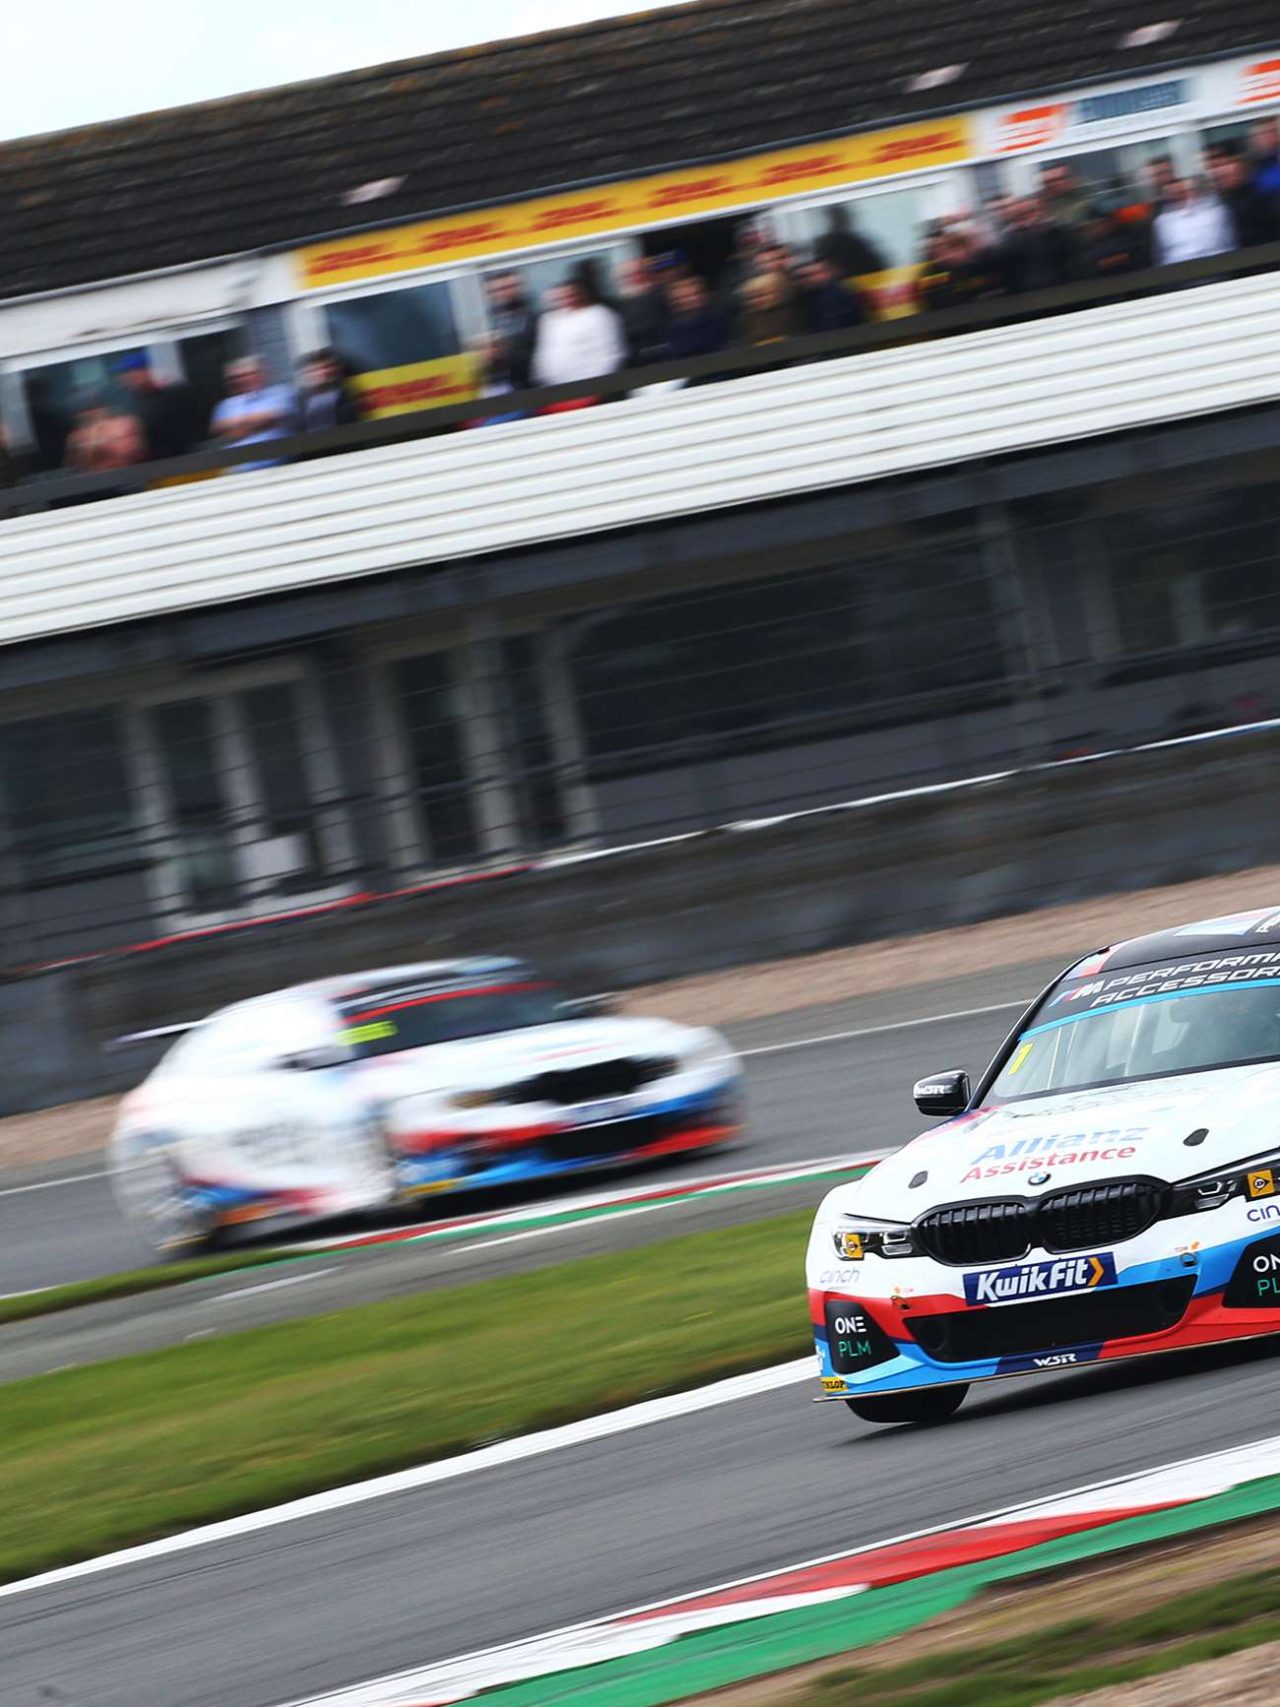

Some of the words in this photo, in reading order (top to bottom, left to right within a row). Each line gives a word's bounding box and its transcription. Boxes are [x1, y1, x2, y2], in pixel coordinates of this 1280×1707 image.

[1008, 1042, 1034, 1076] 1
[970, 1126, 1150, 1166] Allianz
[960, 1146, 1136, 1184] Assistance
[820, 1267, 860, 1284] cinch
[976, 1265, 1048, 1301] Kwik
[1049, 1259, 1089, 1289] Fit
[834, 1316, 867, 1335] ONE
[838, 1341, 872, 1358] PLM
[1033, 1353, 1077, 1367] WSR
